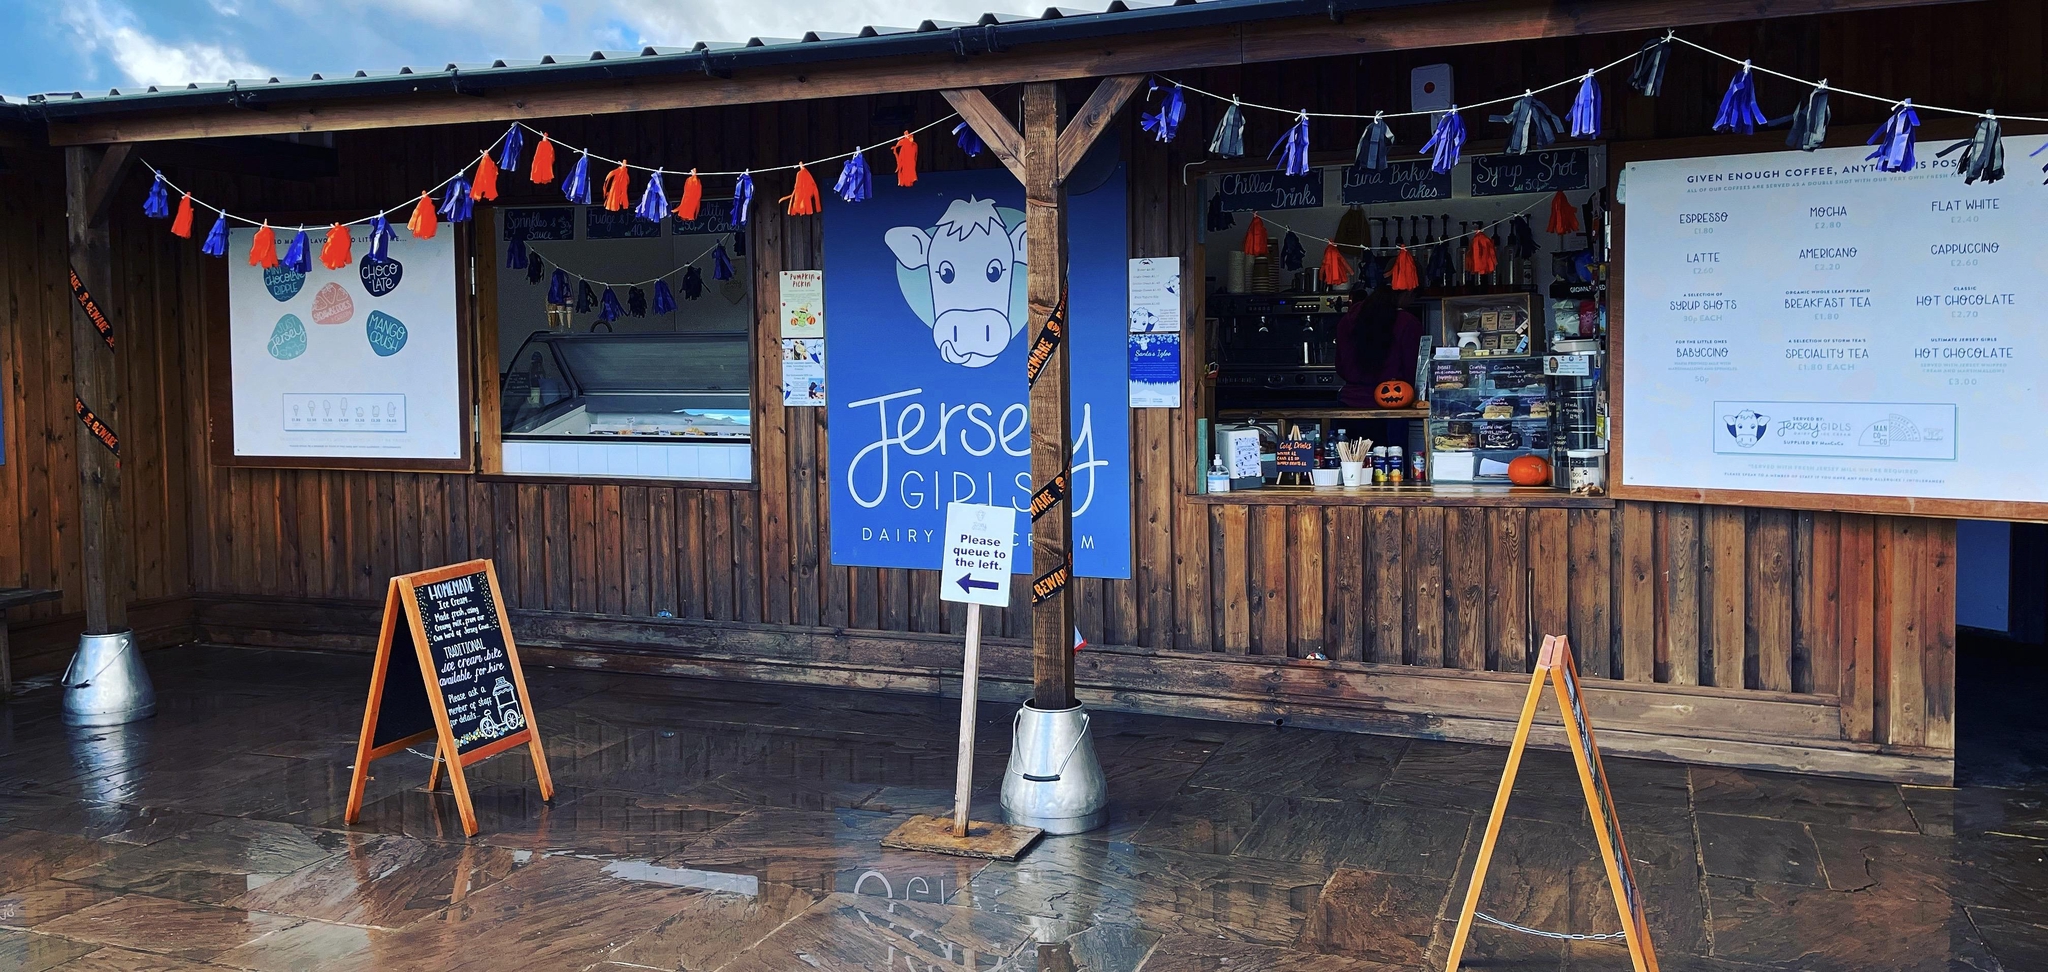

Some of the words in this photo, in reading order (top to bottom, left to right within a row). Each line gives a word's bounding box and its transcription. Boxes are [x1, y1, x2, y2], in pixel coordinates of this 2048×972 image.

[1389, 161, 1434, 185] Bakes
[1476, 156, 1523, 187] Syrup
[1537, 151, 1577, 182] Shot
[1687, 173, 1723, 184] GIVEN
[1728, 170, 1780, 181] ENOUGH
[1785, 166, 1838, 178] COFFEE,
[1842, 163, 1879, 174] ANYT
[1916, 160, 1926, 170] IS
[1222, 173, 1275, 195] Chilled
[1809, 205, 1847, 218] MOCHA
[1931, 199, 1961, 212] FLAT
[1965, 198, 2000, 210] WHITE
[507, 210, 547, 235] Sprinkles
[588, 207, 616, 232] Fudge
[1679, 211, 1729, 224] ESPRESSO
[1951, 215, 1979, 223] £2.40
[1694, 227, 1714, 235] £1.80
[1814, 221, 1842, 229] £2.80
[527, 227, 553, 240] Sauce
[1799, 246, 1858, 259] AMERICANO
[1930, 242, 2000, 255] CAPPUCCINO
[1686, 252, 1720, 263] LATTE
[1950, 259, 1979, 267] £2.60
[361, 263, 398, 280] CHOCO
[1814, 263, 1841, 271] £2.20
[789, 273, 815, 282] PUMPKIN
[1669, 300, 1701, 311] SYRUP
[1703, 299, 1737, 310] SHOTS
[1784, 297, 1845, 309] BREAKFAST
[1849, 296, 1871, 308] TEA
[1916, 295, 1941, 306] HOT
[1944, 293, 2015, 306] CHOCOLATE
[86, 301, 110, 333] BEWARE
[1951, 310, 1979, 318] £2.70
[369, 314, 406, 339] MANGO
[268, 324, 306, 357] Jersey
[370, 332, 400, 351] CRUSH
[1027, 337, 1053, 379] BEWARE
[1676, 347, 1729, 358] BABYCCINO
[1785, 348, 1844, 359] SPECIALITY
[1848, 348, 1869, 359] TEA
[1914, 347, 1939, 359] HOT
[1943, 347, 2014, 359] CHOCOLATE
[91, 421, 118, 449] BEWARE
[1777, 419, 1820, 438] Jersey
[1820, 422, 1851, 431] GIRLS
[848, 387, 1109, 518] Jersey
[862, 527, 934, 544] DAIRY
[960, 533, 1001, 547] Please
[953, 547, 990, 557] queue
[994, 549, 1007, 559] to
[955, 557, 975, 567] the
[978, 559, 1003, 571] left.
[427, 575, 474, 600] HOMEMADE
[437, 600, 450, 611] Ice
[434, 611, 450, 622] Made
[466, 607, 480, 615] using
[434, 623, 452, 632] Creamy
[443, 630, 455, 639] herd
[456, 629, 462, 638] of
[464, 626, 479, 635] Jersey
[443, 637, 487, 659] TRADITIONAL
[440, 659, 456, 674] ice
[457, 654, 483, 669] cream
[483, 647, 503, 661] bike
[439, 668, 473, 687] available
[474, 667, 487, 683] for
[486, 661, 505, 674] hire
[447, 692, 467, 704] Please
[467, 686, 479, 698] ask
[480, 685, 487, 694] a
[448, 703, 468, 716] member
[469, 701, 477, 712] of
[477, 696, 493, 707] staff
[449, 719, 458, 729] for
